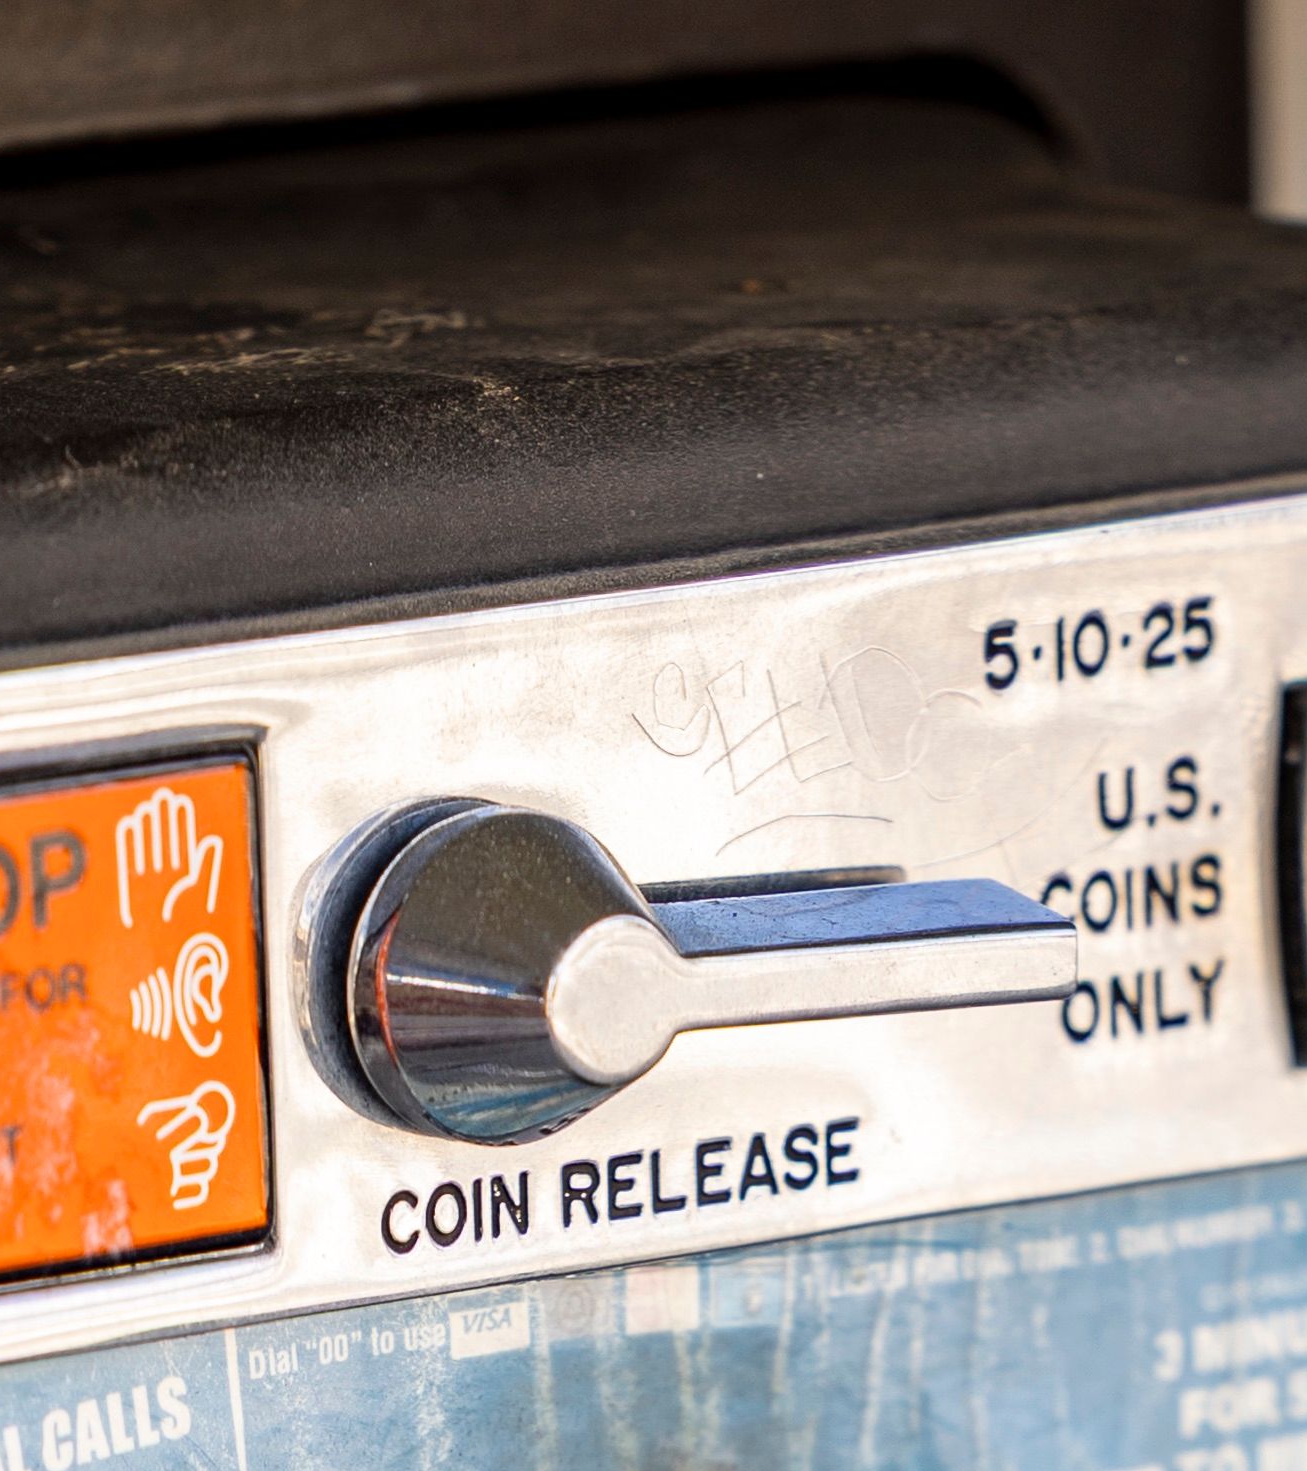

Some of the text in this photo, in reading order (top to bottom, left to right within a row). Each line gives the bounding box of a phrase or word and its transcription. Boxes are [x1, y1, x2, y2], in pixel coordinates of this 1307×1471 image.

[1096, 757, 1222, 830] U.S.
[1061, 960, 1226, 1043] ONLY
[380, 1117, 861, 1256] COIN RELEASE
[249, 1338, 299, 1380] Dial
[371, 1325, 394, 1356] to
[403, 1322, 447, 1352] use
[461, 1310, 513, 1336] VISA
[1178, 1374, 1282, 1440] FOR
